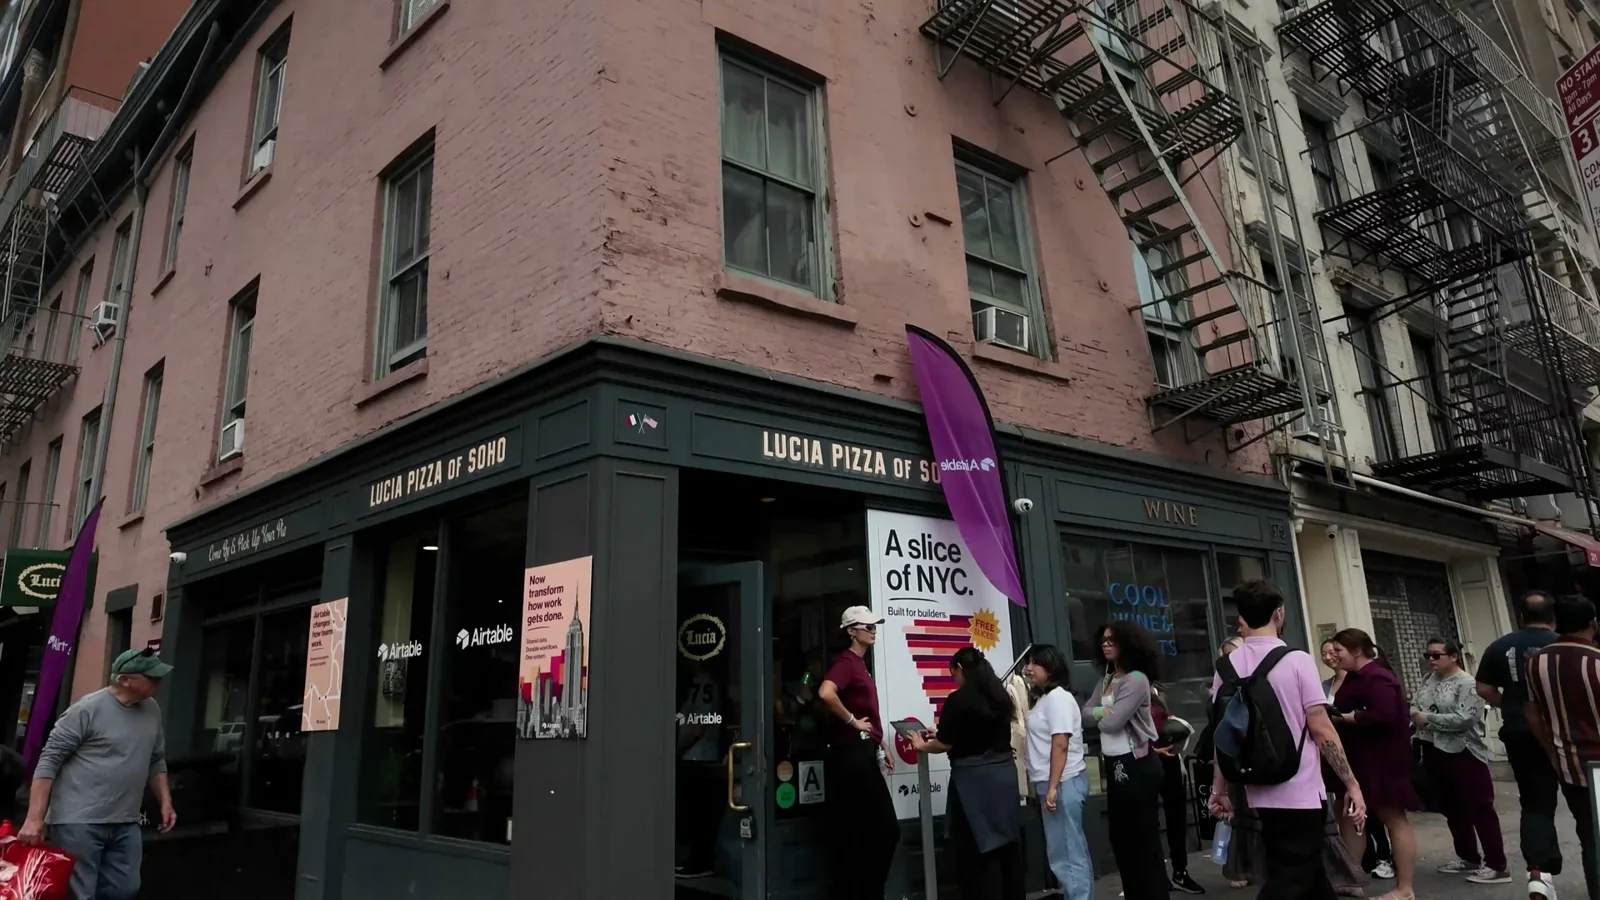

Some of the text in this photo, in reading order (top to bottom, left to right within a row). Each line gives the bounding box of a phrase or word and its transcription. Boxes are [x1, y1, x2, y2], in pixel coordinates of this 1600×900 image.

[1560, 76, 1573, 93] NO
[1564, 90, 1577, 105] 1pm
[1582, 73, 1597, 89] 7pm
[1567, 91, 1592, 115] All Days
[1578, 128, 1592, 153] 3
[763, 431, 942, 484] LUCIA PIZZA OF SO
[370, 436, 507, 507] LUCIA PIZZA OF SOHO
[1143, 498, 1198, 527] WINE
[208, 544, 222, 562] Come
[222, 539, 230, 562] By
[237, 533, 250, 552] Pick
[251, 528, 260, 551] Up
[261, 523, 275, 543] Your
[276, 518, 287, 538] Pie
[885, 529, 962, 564] A slice
[30, 575, 61, 588] Luci
[529, 575, 546, 586] Now
[886, 564, 974, 596] of NYC.
[528, 585, 564, 599] transform
[1109, 583, 1170, 607] COOL
[527, 596, 562, 611] how work
[887, 606, 948, 619] Built for builders.
[312, 619, 331, 630] changes
[527, 611, 564, 626] gets done.
[975, 618, 995, 633] FREE
[471, 623, 513, 647] Airtable
[685, 627, 716, 646] Lucia
[388, 640, 422, 660] Airtable
[687, 711, 722, 725] Airtable
[804, 766, 821, 792] A
[911, 781, 941, 796] Aible
